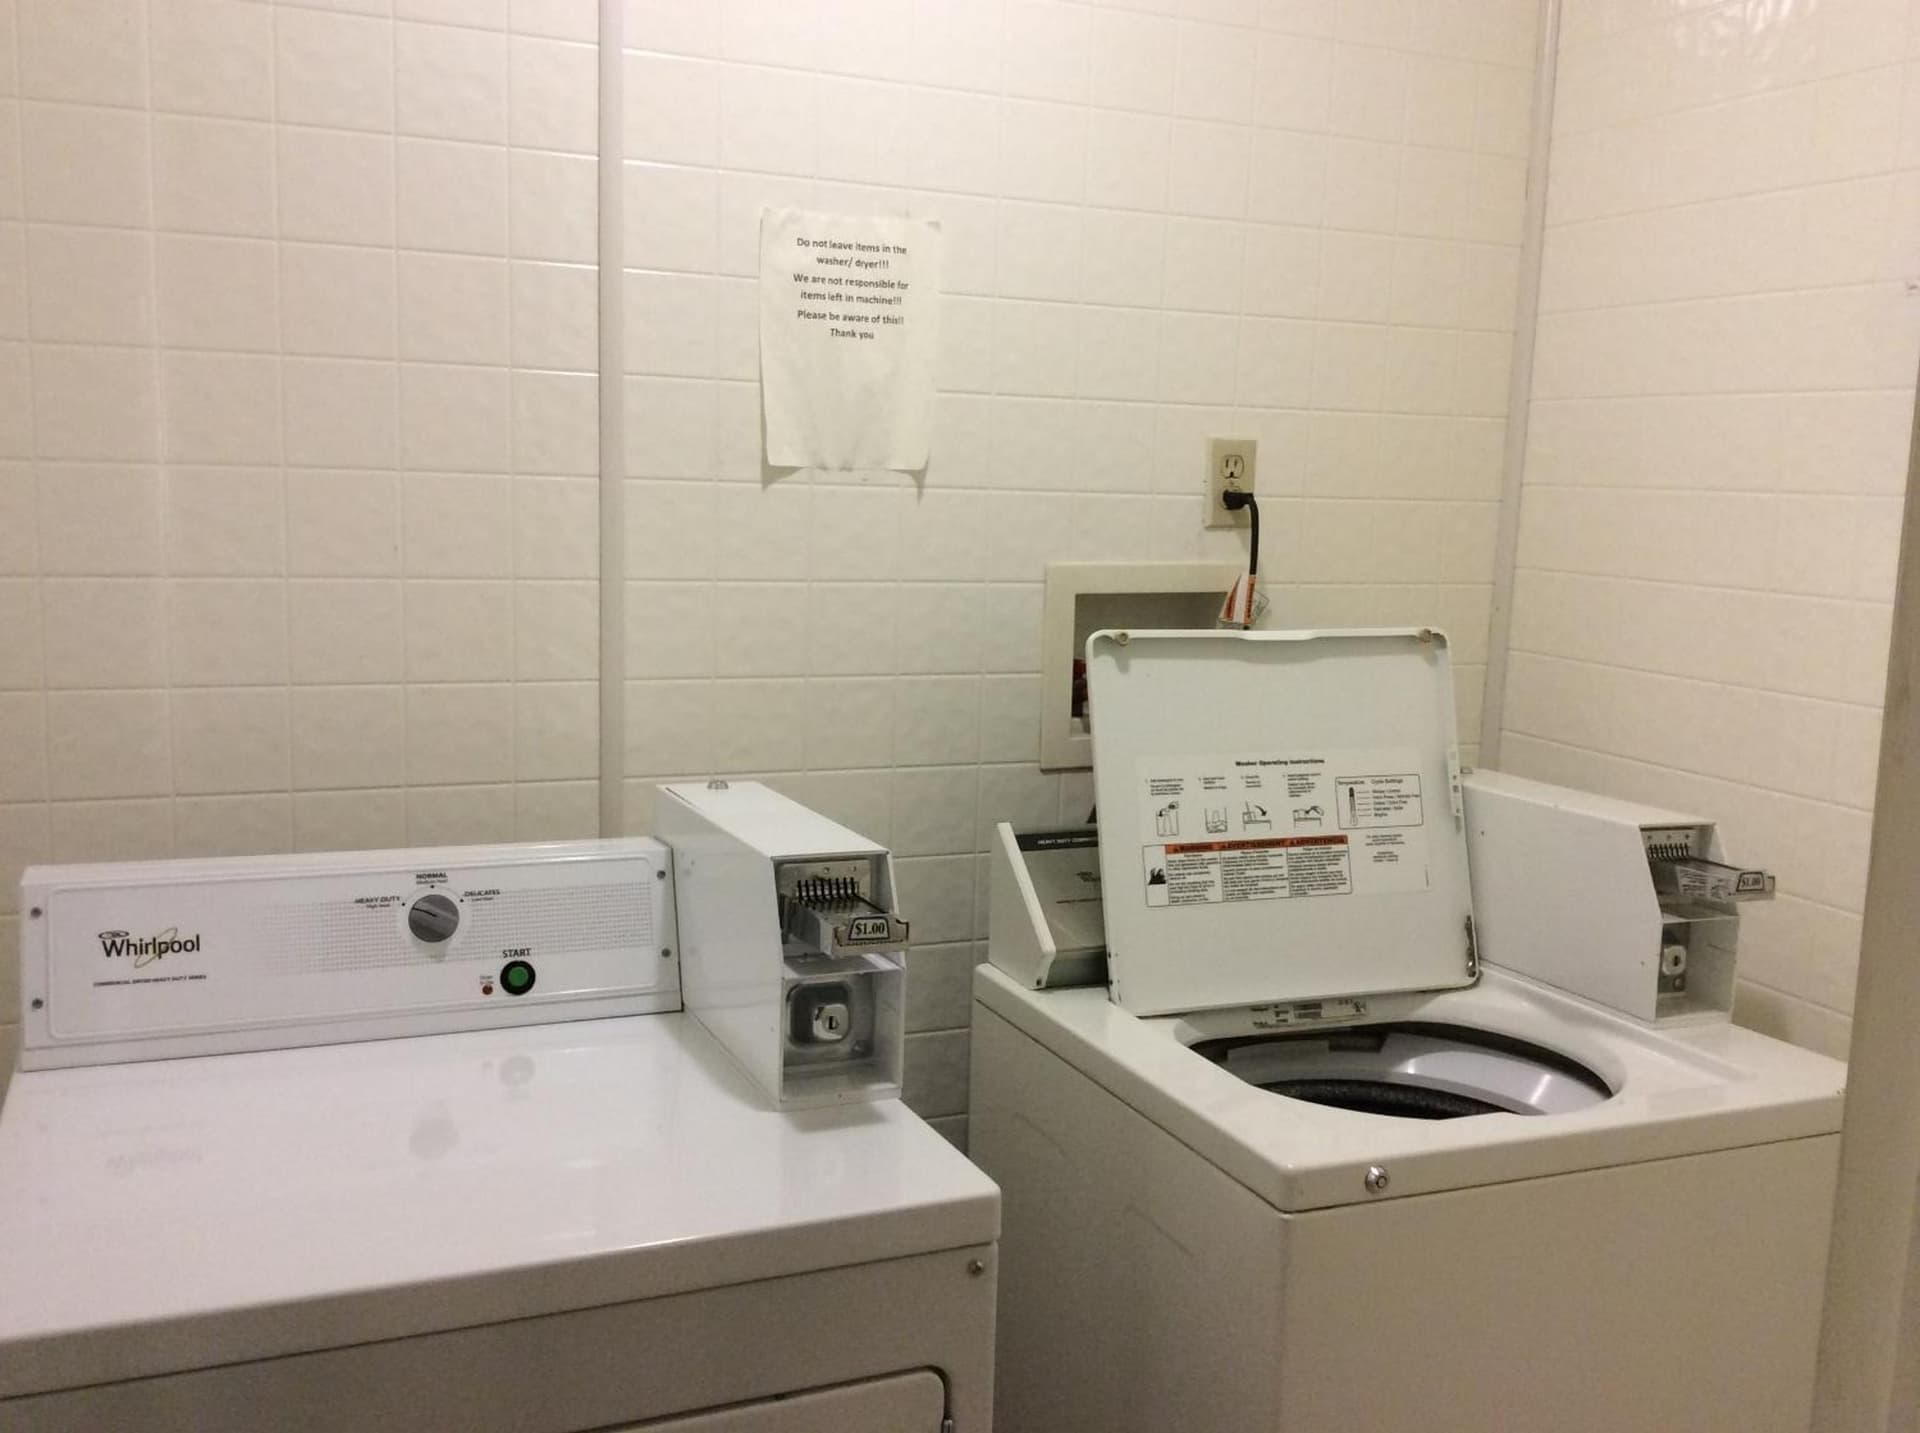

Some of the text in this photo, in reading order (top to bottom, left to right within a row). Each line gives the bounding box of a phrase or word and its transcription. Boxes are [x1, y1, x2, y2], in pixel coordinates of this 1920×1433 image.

[797, 238, 907, 255] Do not leave items in the
[816, 256, 889, 270] washer/ dryer!!!
[793, 274, 809, 283] We
[828, 276, 843, 285] not
[845, 278, 895, 289] responsible
[897, 281, 909, 290] for
[800, 291, 902, 305] items left in machine!!!
[797, 310, 827, 320] Please
[829, 312, 840, 321] be
[842, 315, 869, 323] aware
[871, 314, 880, 323] of
[830, 328, 874, 340] Thank you
[416, 872, 448, 880] NORMAL
[856, 920, 885, 935] $1.00
[102, 933, 200, 960] Whirlpool
[502, 948, 532, 958] START
